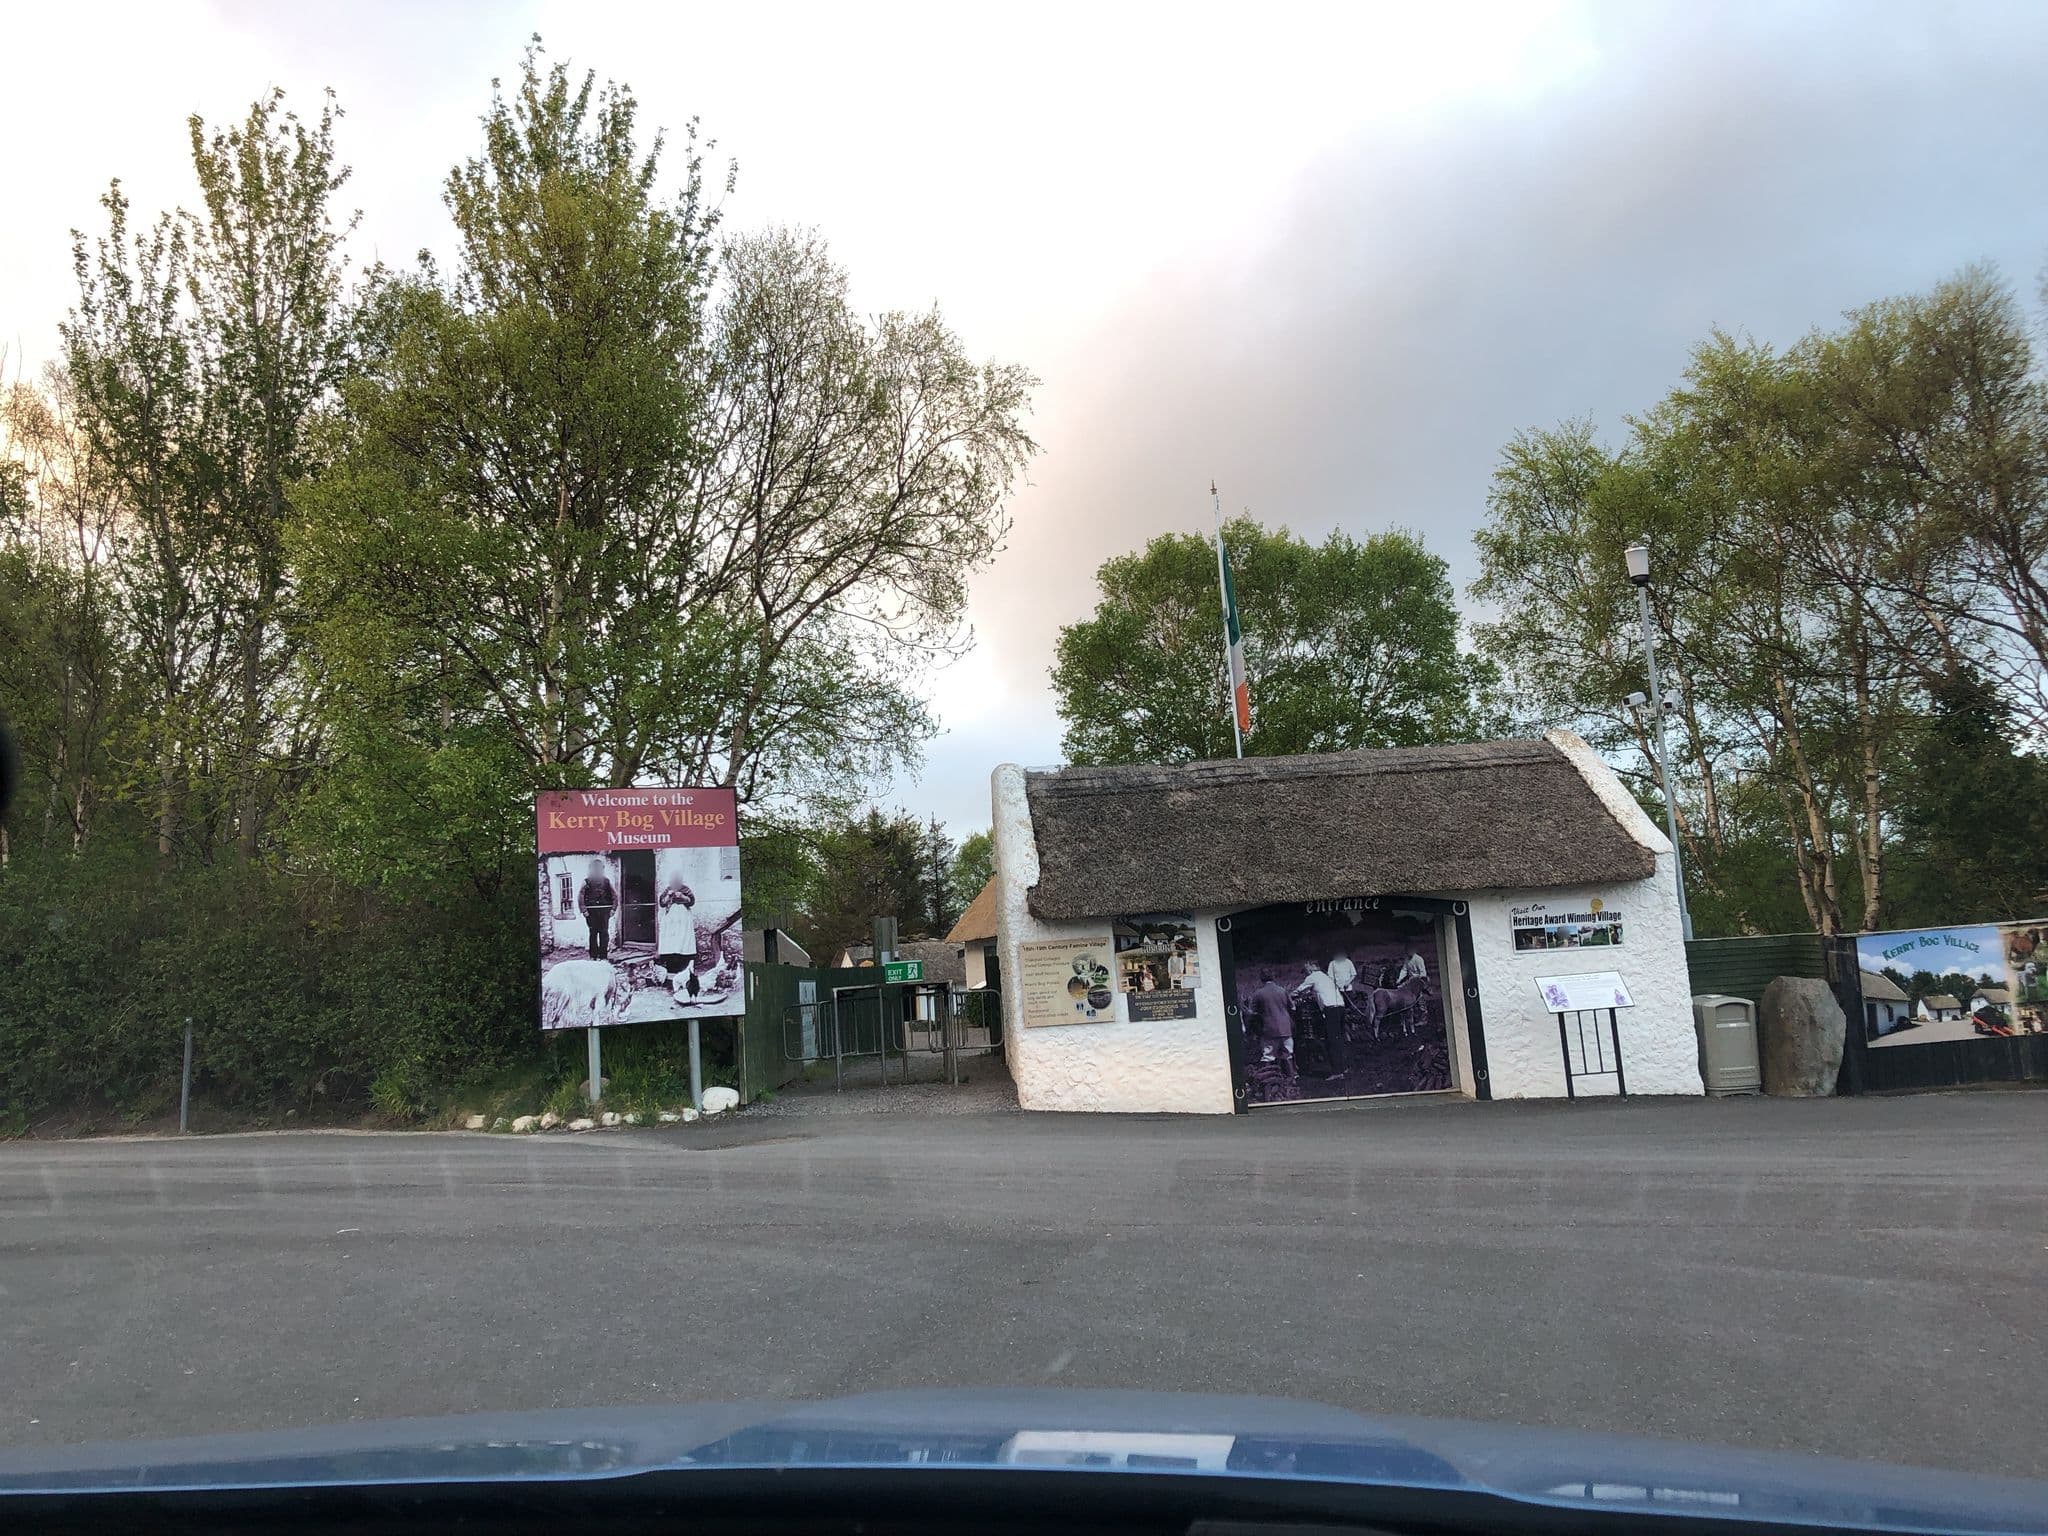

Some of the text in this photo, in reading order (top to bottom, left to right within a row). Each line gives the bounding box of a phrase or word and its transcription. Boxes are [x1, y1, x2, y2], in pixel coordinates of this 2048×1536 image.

[582, 793, 694, 807] Welcome to the
[549, 809, 725, 832] Kerry Bog Village
[607, 831, 671, 845] Museum
[1306, 898, 1379, 913] entrance
[1531, 903, 1546, 912] Our
[1513, 910, 1622, 927] Heritage Award Winning Village
[1882, 934, 1980, 961] KERRY BOG VILLAGE
